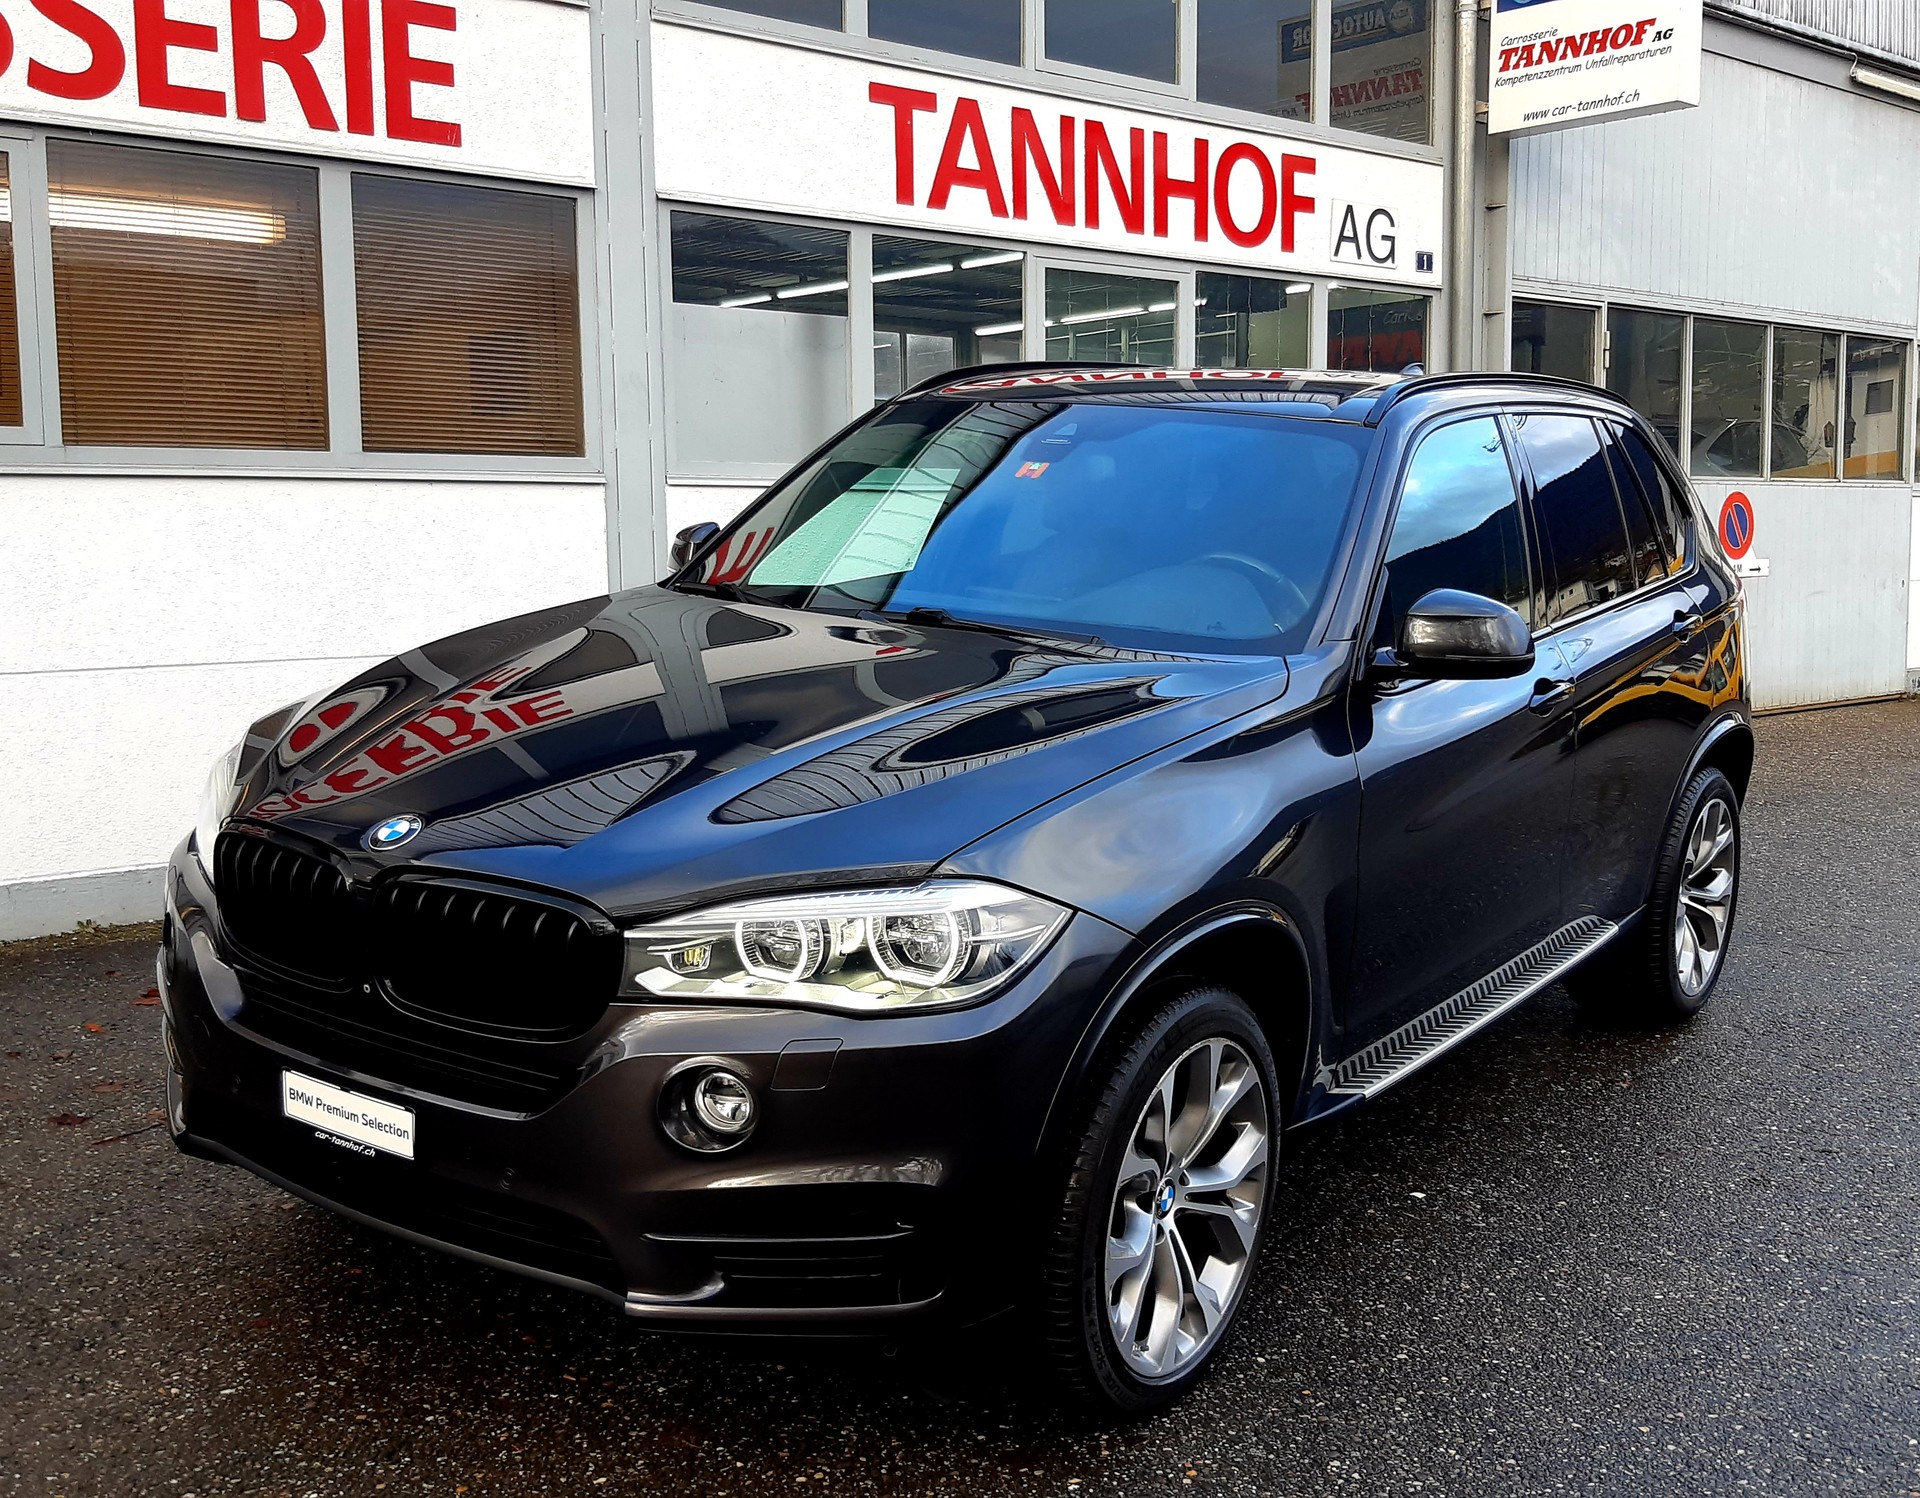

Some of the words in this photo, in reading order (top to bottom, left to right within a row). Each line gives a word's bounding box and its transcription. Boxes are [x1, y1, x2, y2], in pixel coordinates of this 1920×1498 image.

[1498, 17, 1657, 73] TANNHOF
[1653, 28, 1674, 42] AG
[1500, 27, 1558, 47] Carrosserie
[0, 0, 461, 147] SERIE
[1494, 64, 1582, 88] Kompetenzzentrum
[1585, 44, 1672, 71] Unfallreparaturen
[869, 82, 1316, 253] TANNHOF
[1333, 204, 1396, 264] AG
[289, 1088, 313, 1107] BMW
[316, 1098, 359, 1123] Premium
[361, 1114, 410, 1140] Selection
[314, 1130, 375, 1157] car-tannhof.ch
